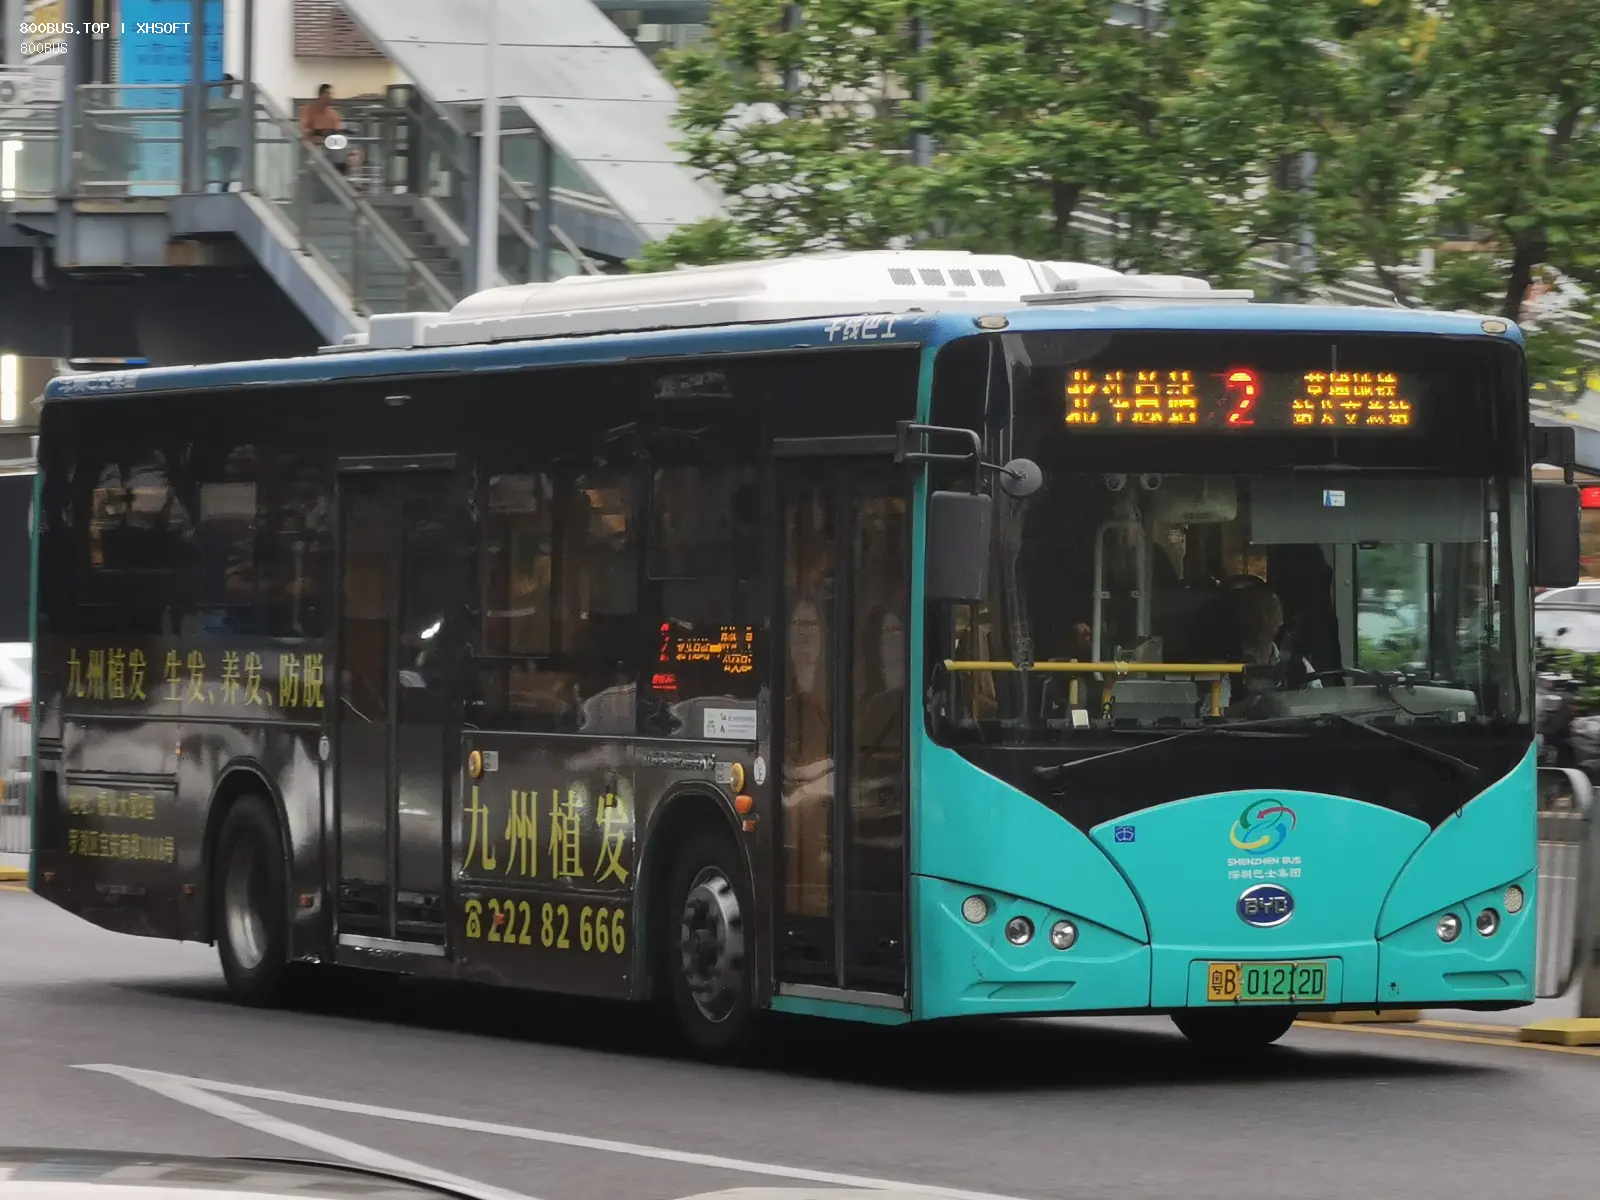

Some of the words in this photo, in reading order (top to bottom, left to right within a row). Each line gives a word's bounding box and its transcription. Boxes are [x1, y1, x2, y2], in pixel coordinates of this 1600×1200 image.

[1226, 370, 1258, 426] 2
[66, 648, 147, 702] 九州植发
[460, 785, 629, 885] 九州植发
[1227, 857, 1280, 867] SHENZHEN
[1281, 856, 1302, 865] BUS
[1227, 868, 1302, 880] 深圳巴士集团
[487, 898, 532, 945] 222
[540, 902, 570, 949] 82
[579, 906, 626, 954] 666
[1244, 896, 1289, 915] BYD
